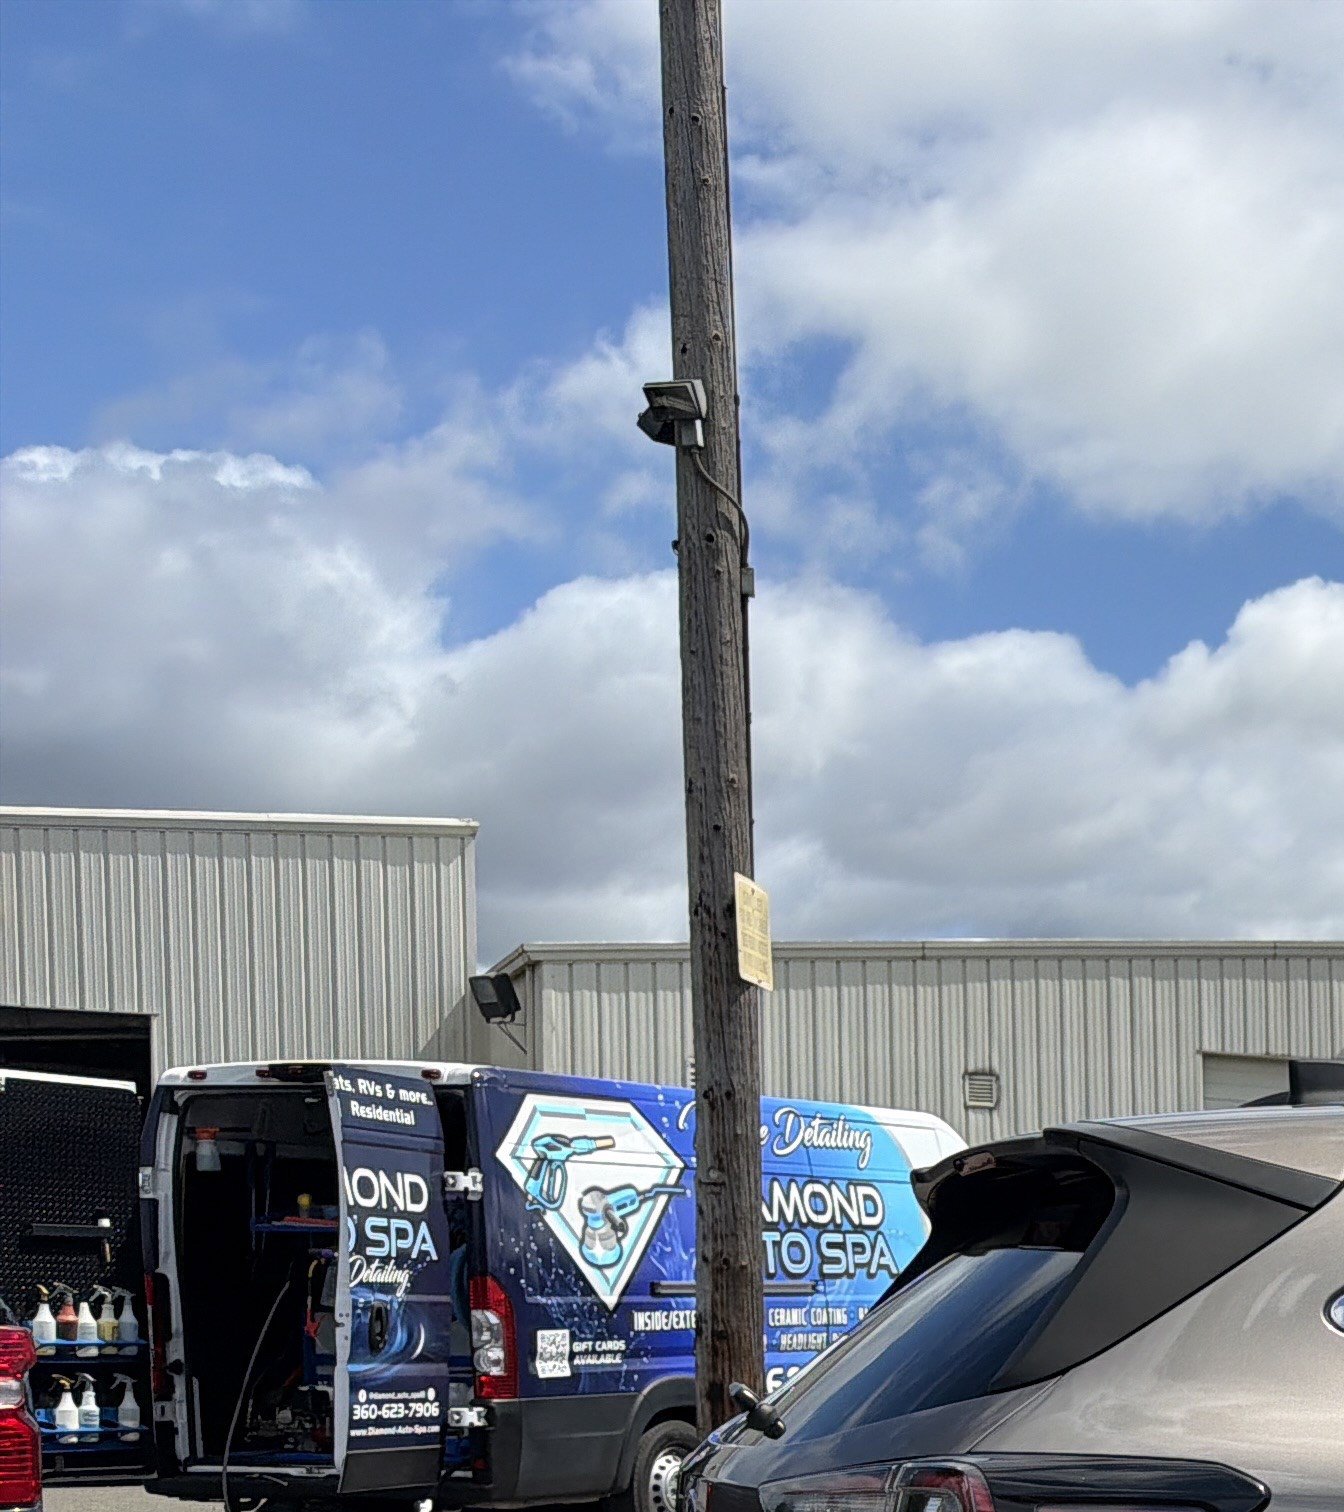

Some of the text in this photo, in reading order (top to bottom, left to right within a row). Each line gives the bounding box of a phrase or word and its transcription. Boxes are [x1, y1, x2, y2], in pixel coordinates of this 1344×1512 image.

[358, 1079, 383, 1097] RVs
[386, 1083, 396, 1099] &
[350, 1100, 415, 1125] Residential
[773, 1107, 873, 1169] Detailing
[364, 1216, 438, 1260] SPA
[820, 1231, 900, 1274] SPA
[349, 1255, 409, 1298] Detailing
[768, 1307, 808, 1326] CERAMIC
[810, 1307, 848, 1325] COATING
[572, 1339, 626, 1352] GIFT CARDS
[780, 1332, 828, 1351] HEADLIGHT
[573, 1353, 623, 1365] AVAILABLE
[352, 1402, 440, 1420] 360-623-7906
